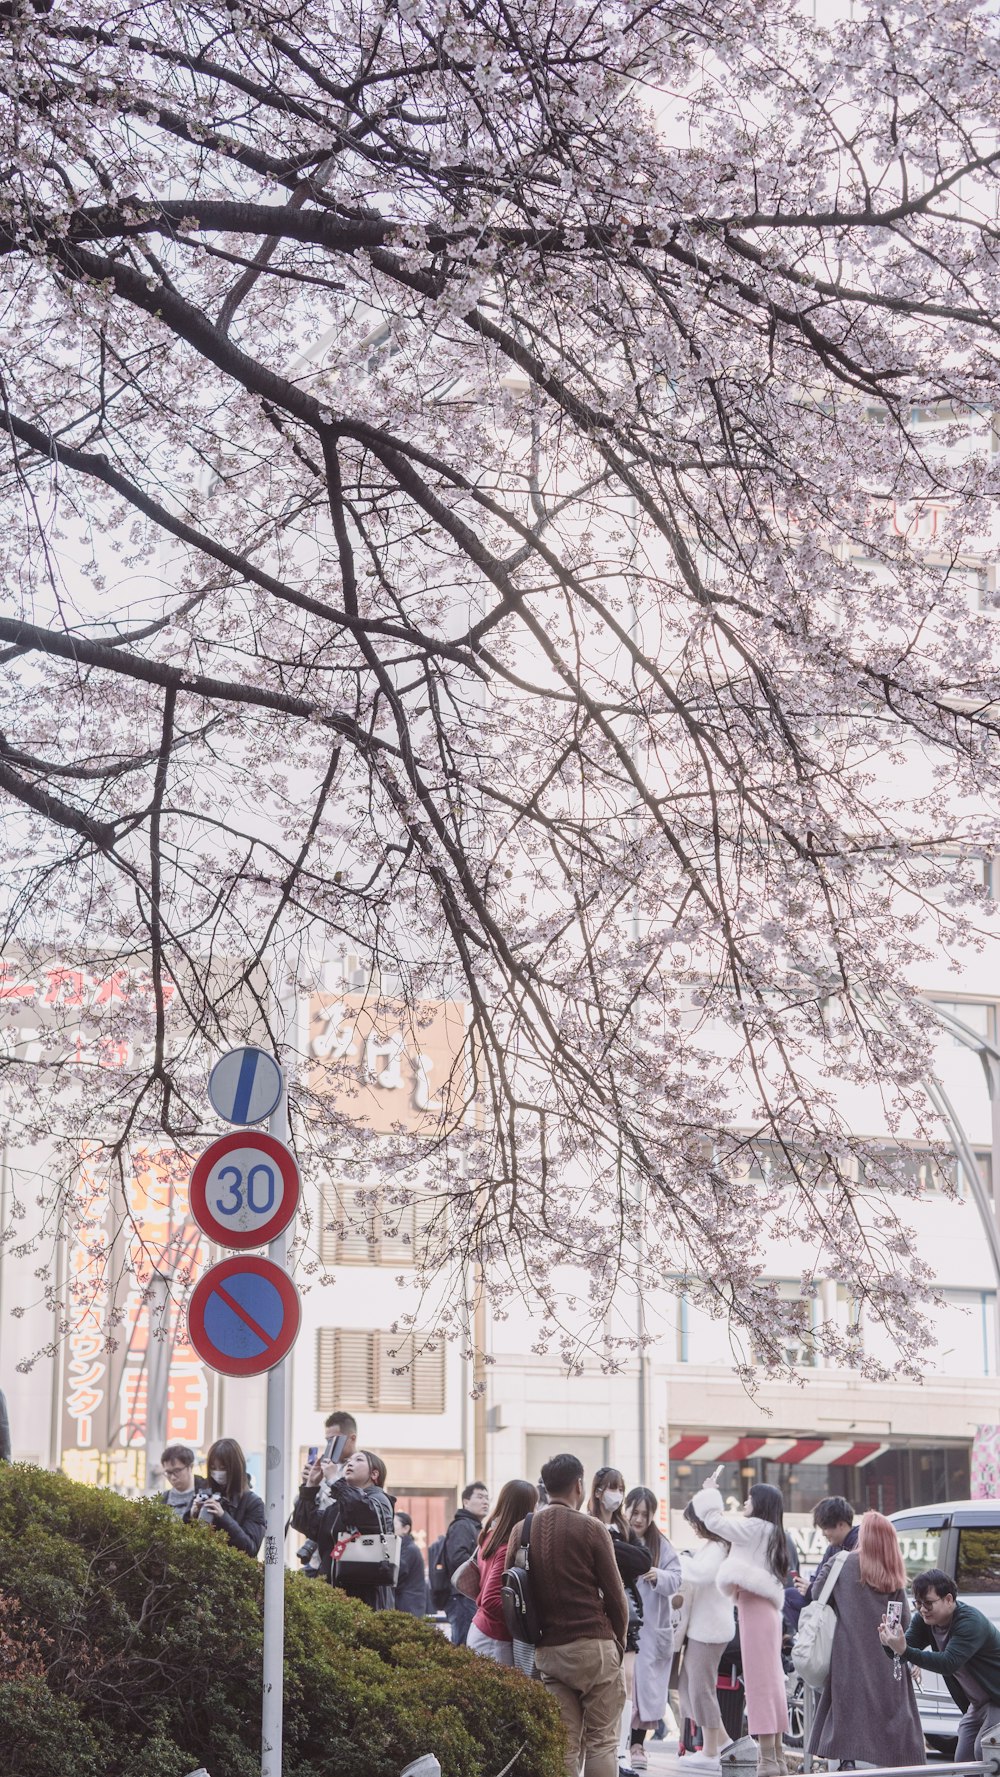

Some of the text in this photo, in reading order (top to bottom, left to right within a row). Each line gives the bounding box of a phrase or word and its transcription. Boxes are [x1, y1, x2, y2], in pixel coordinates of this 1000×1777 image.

[312, 1003, 447, 1111] みはし
[216, 1164, 274, 1215] 30
